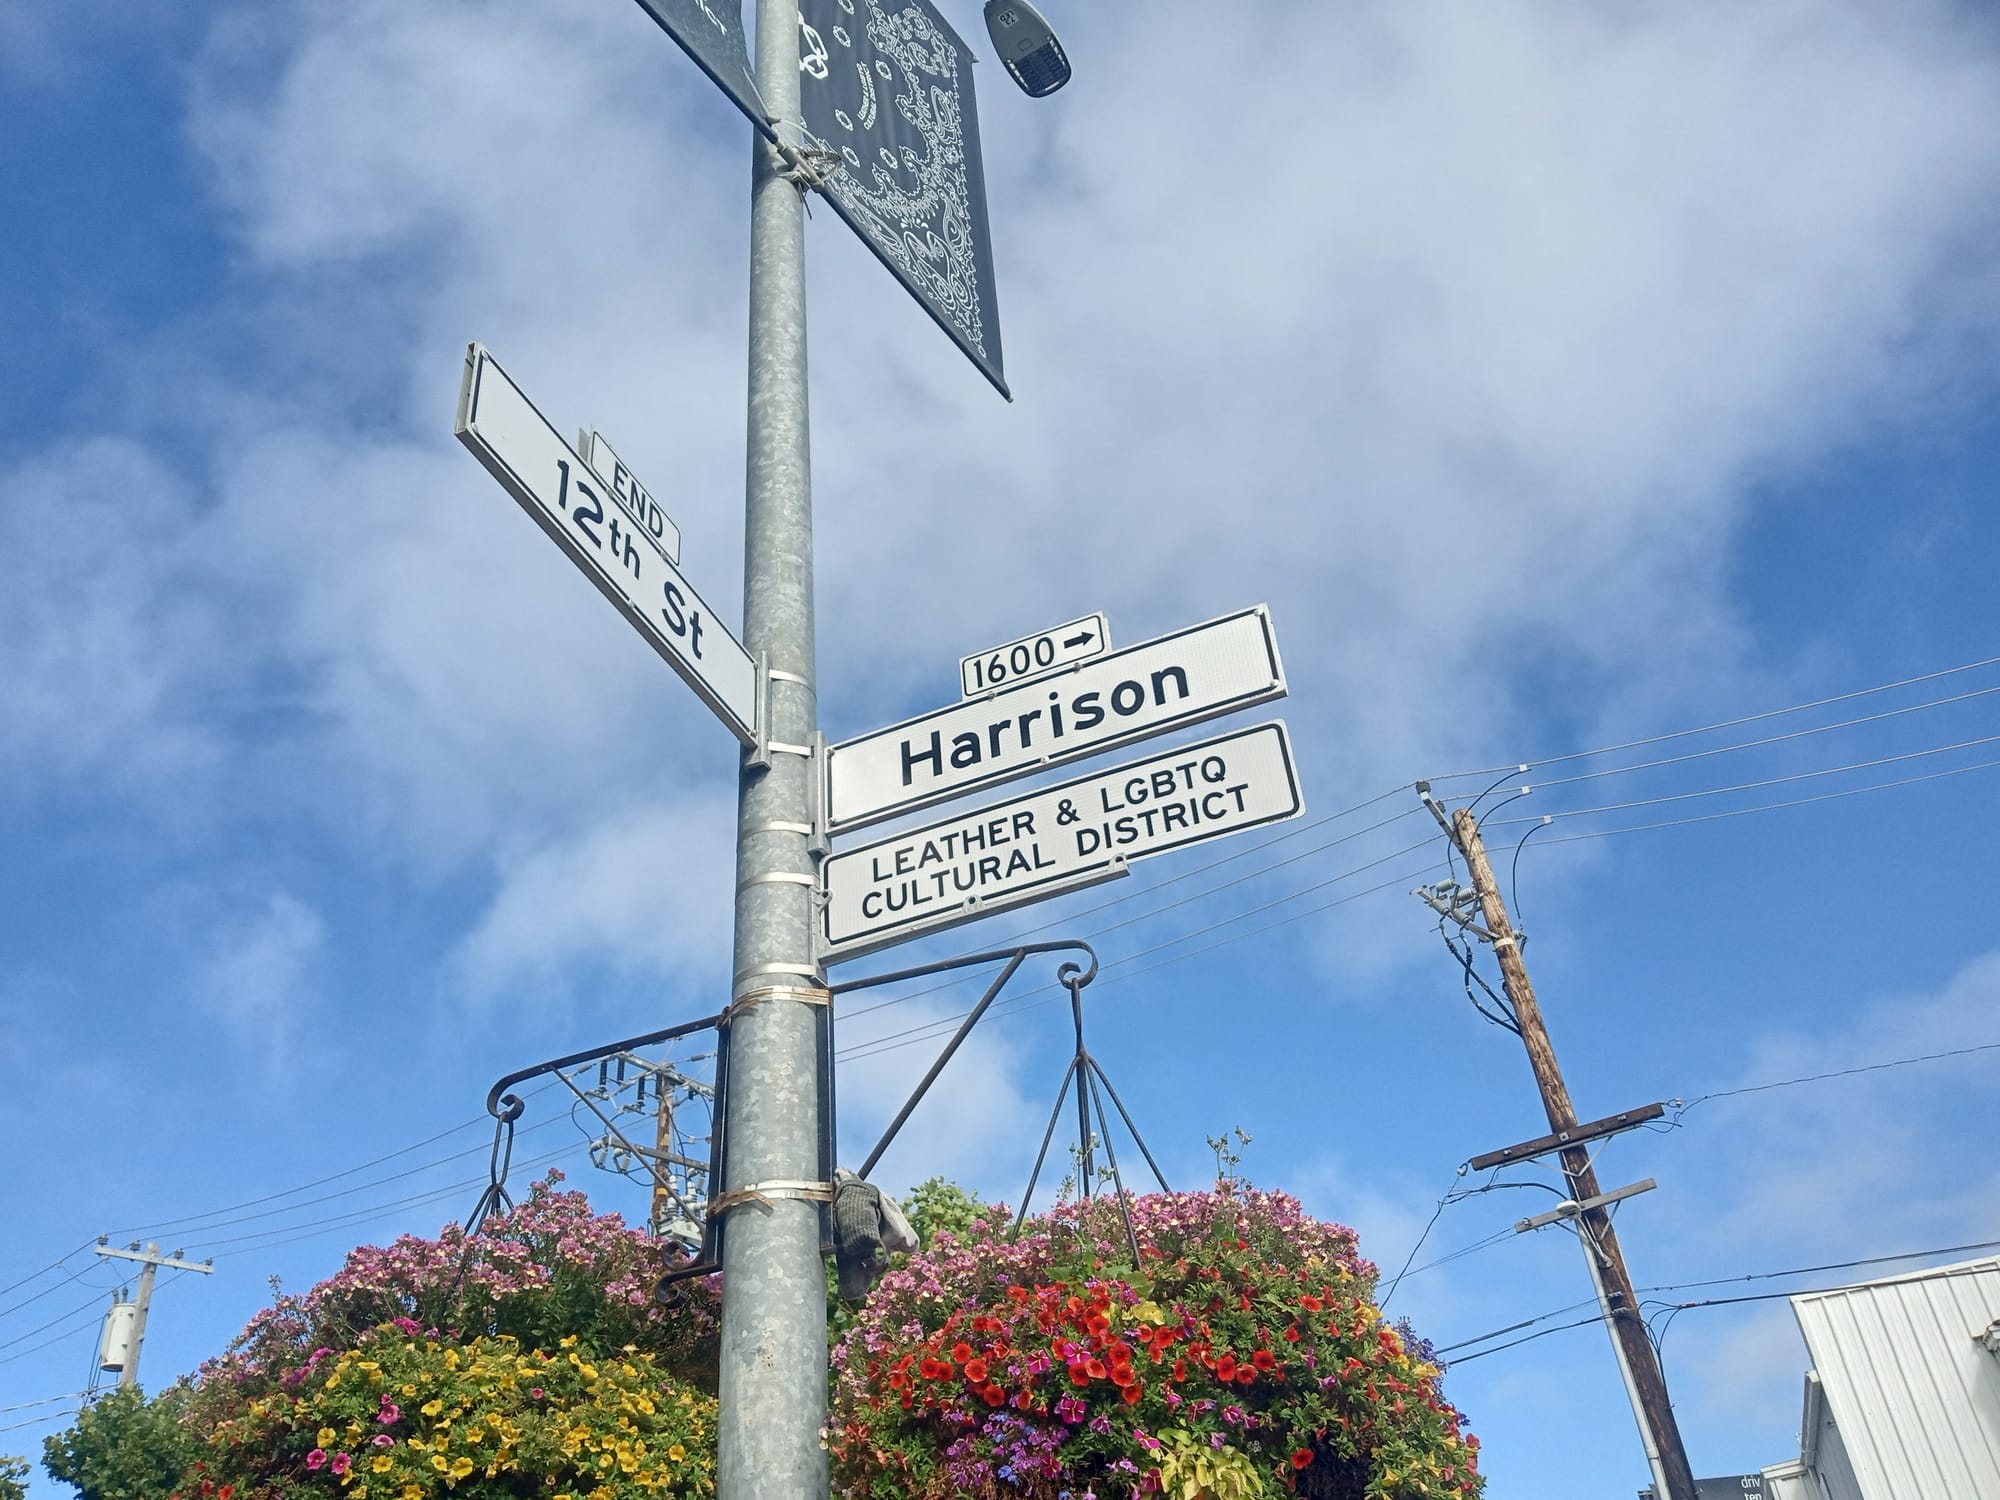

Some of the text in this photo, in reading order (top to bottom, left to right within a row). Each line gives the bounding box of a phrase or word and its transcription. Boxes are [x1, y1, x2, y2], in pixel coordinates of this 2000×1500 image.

[557, 459, 703, 660] 12th St
[614, 461, 664, 538] END
[974, 637, 1055, 688] 1600
[901, 666, 1189, 786] Harrison
[863, 784, 1248, 918] CULTURAL DISTRICT
[873, 756, 1225, 882] LEATHER & LGBTQ
